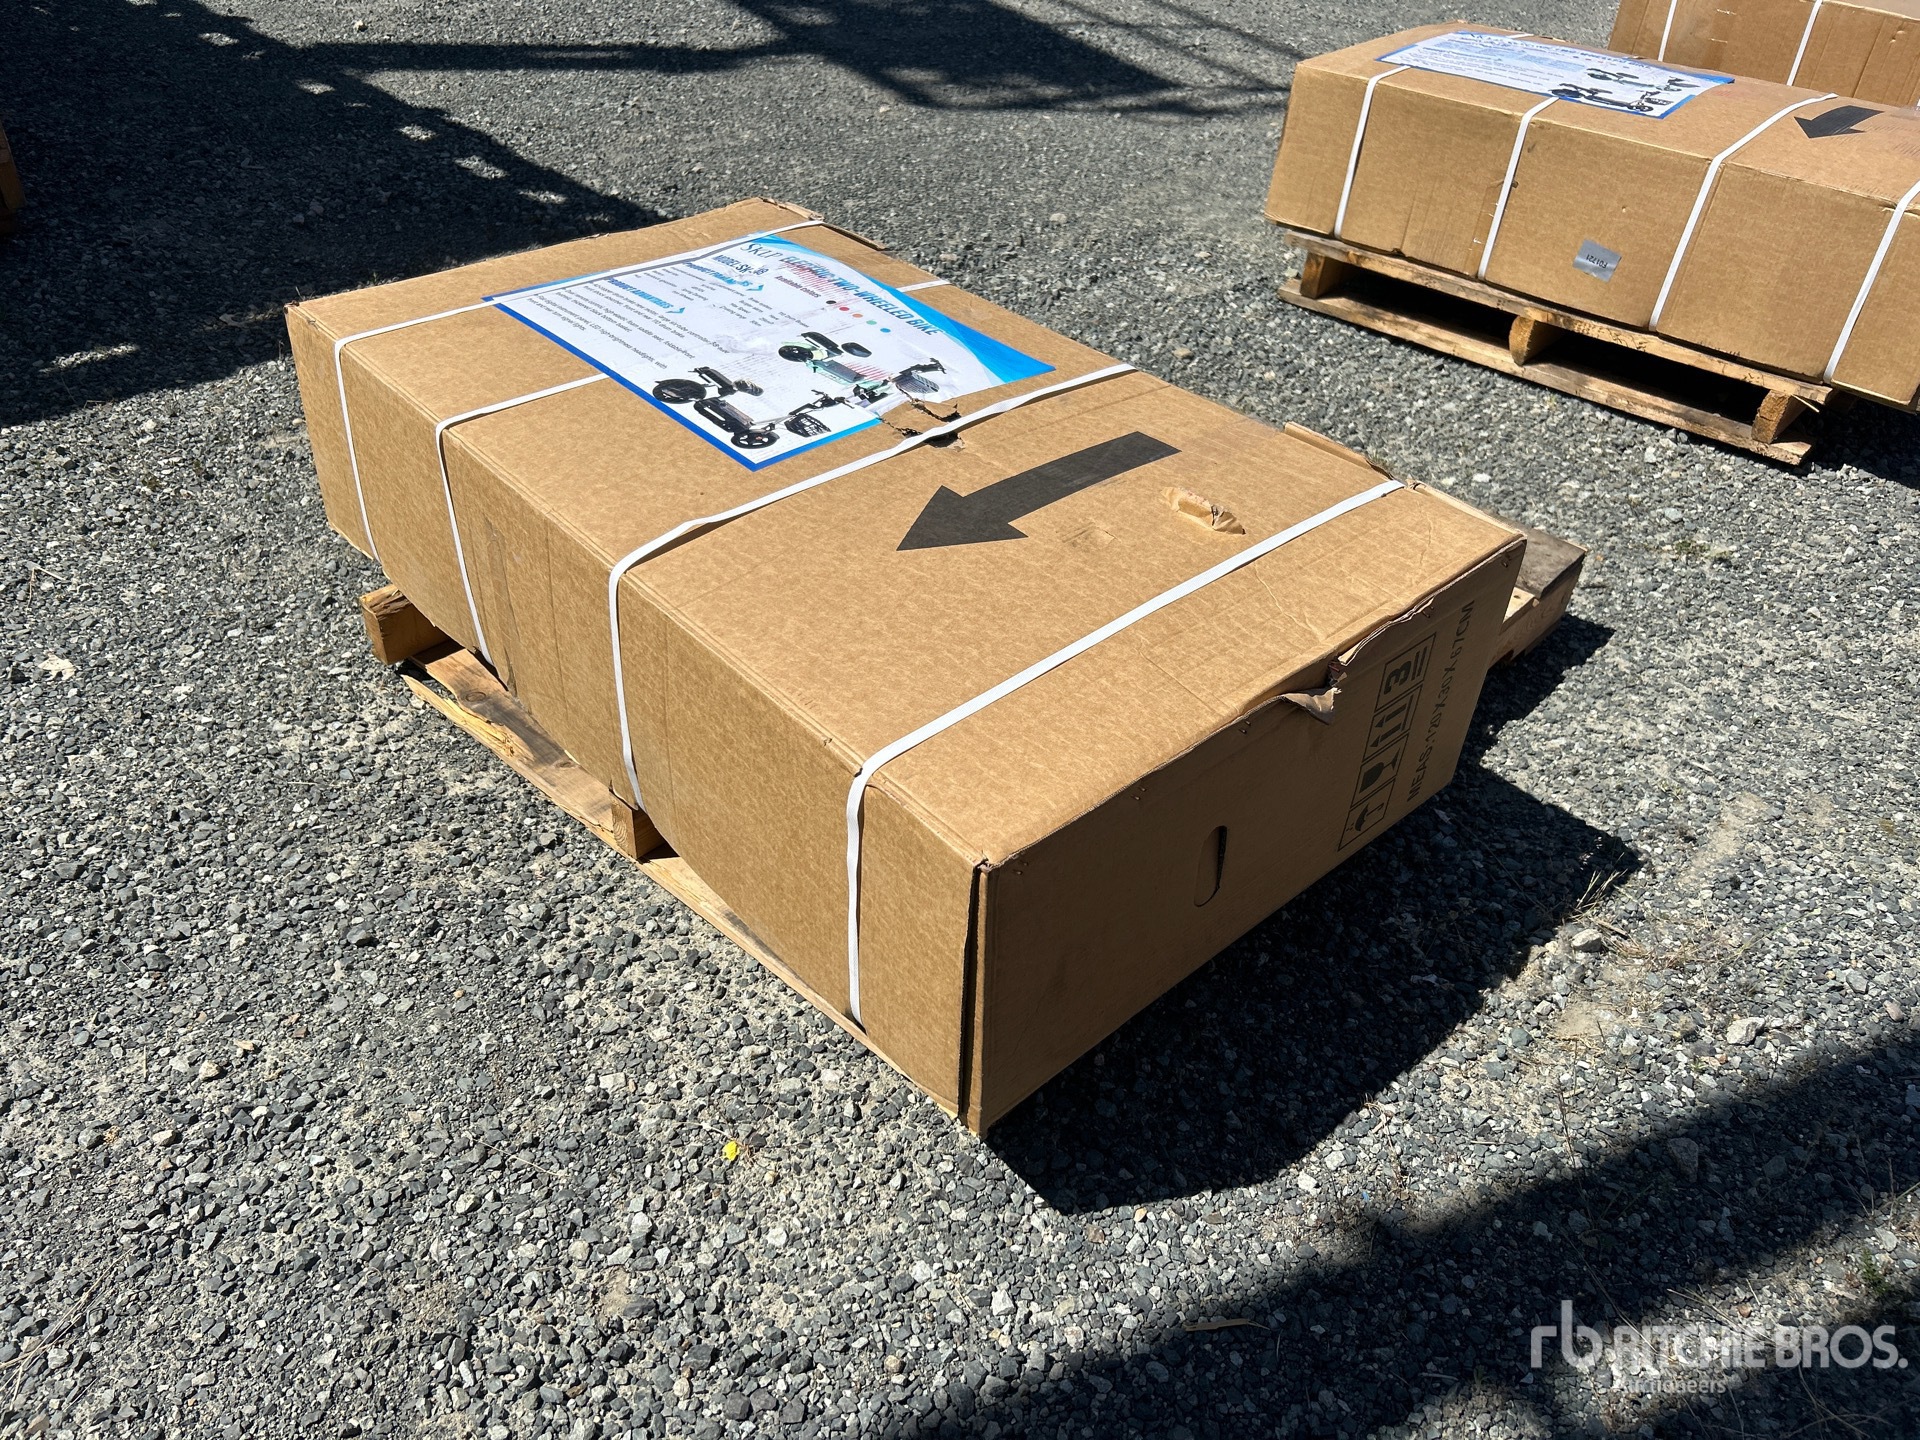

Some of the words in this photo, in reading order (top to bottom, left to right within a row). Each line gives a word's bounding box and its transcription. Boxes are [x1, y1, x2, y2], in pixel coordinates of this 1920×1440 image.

[608, 277, 636, 291] PRODUCT
[780, 256, 836, 280] ELECTRIC
[833, 277, 912, 320] TWO-WHEELED
[906, 316, 944, 336] BIKE
